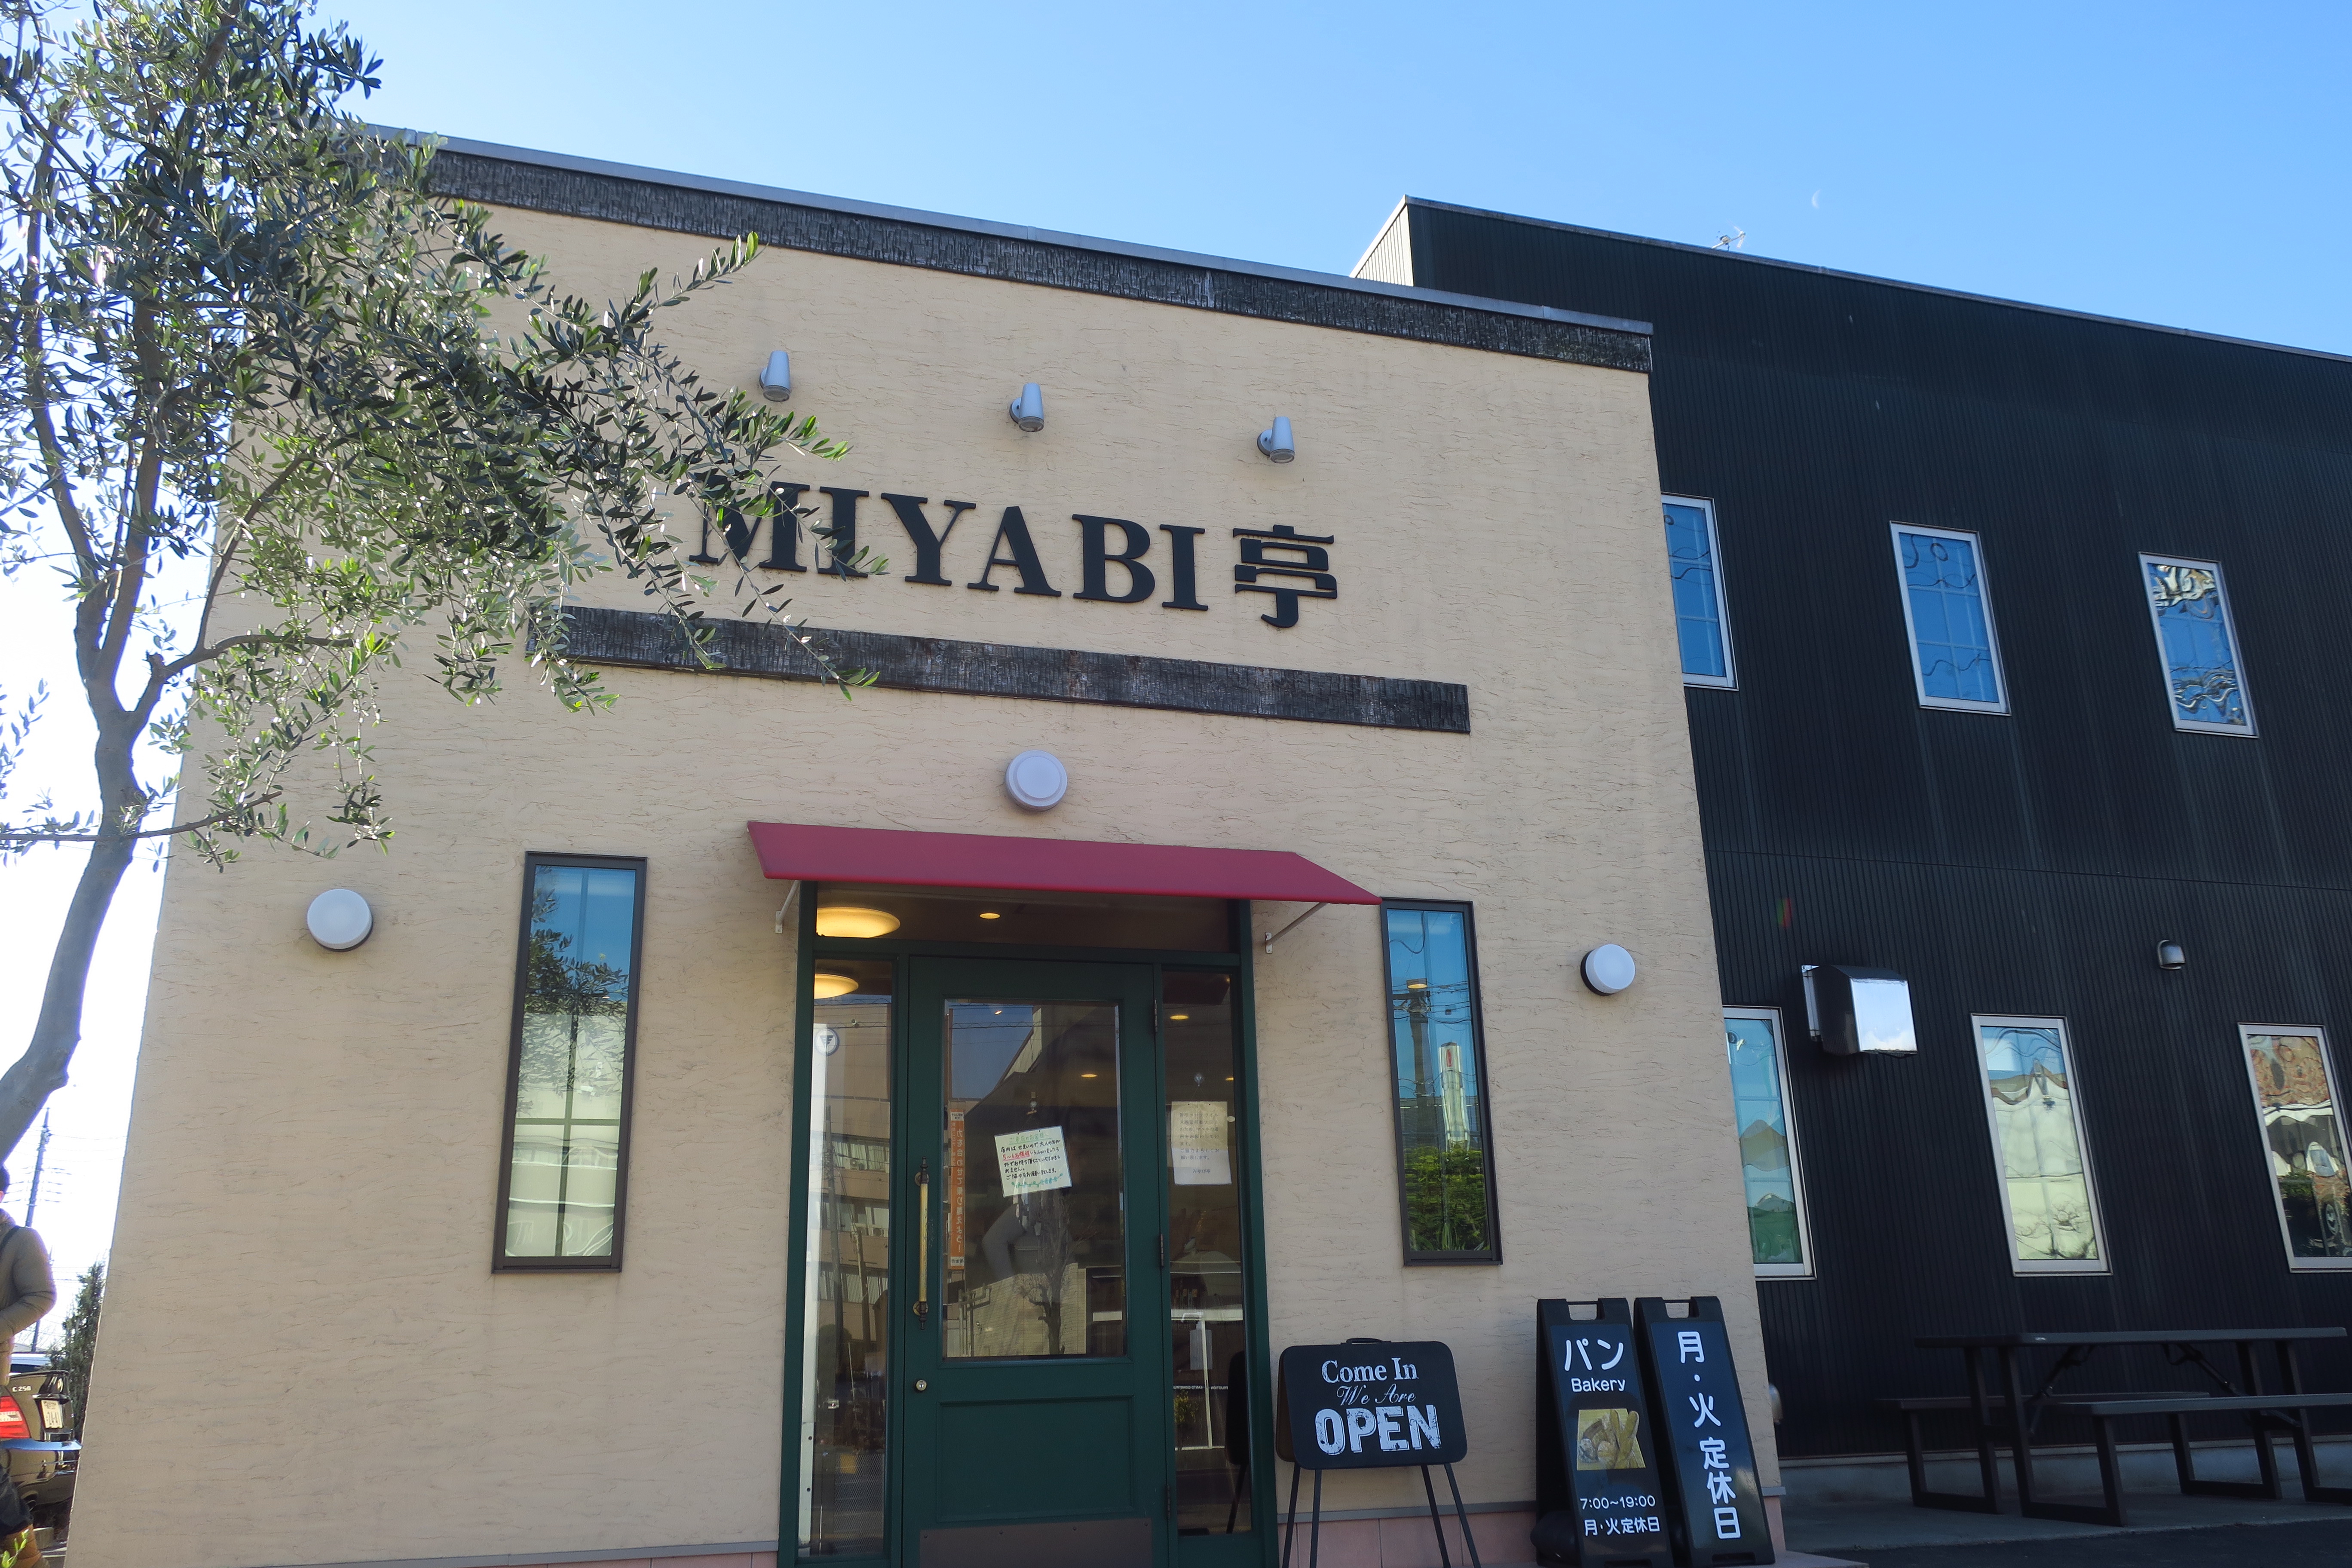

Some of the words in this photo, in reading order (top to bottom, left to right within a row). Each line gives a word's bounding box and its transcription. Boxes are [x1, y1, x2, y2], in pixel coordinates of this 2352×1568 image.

[1564, 1338, 1624, 1371] パン
[1322, 1360, 1387, 1384] Come
[1391, 1357, 1419, 1380] In
[1336, 1384, 1370, 1406] We
[1375, 1383, 1417, 1404] Are
[1571, 1378, 1626, 1392] Bakery
[1315, 1405, 1441, 1455] OPEN
[1677, 1331, 1741, 1540] 月・火定休日
[1584, 1516, 1660, 1536] 月・火定休日
